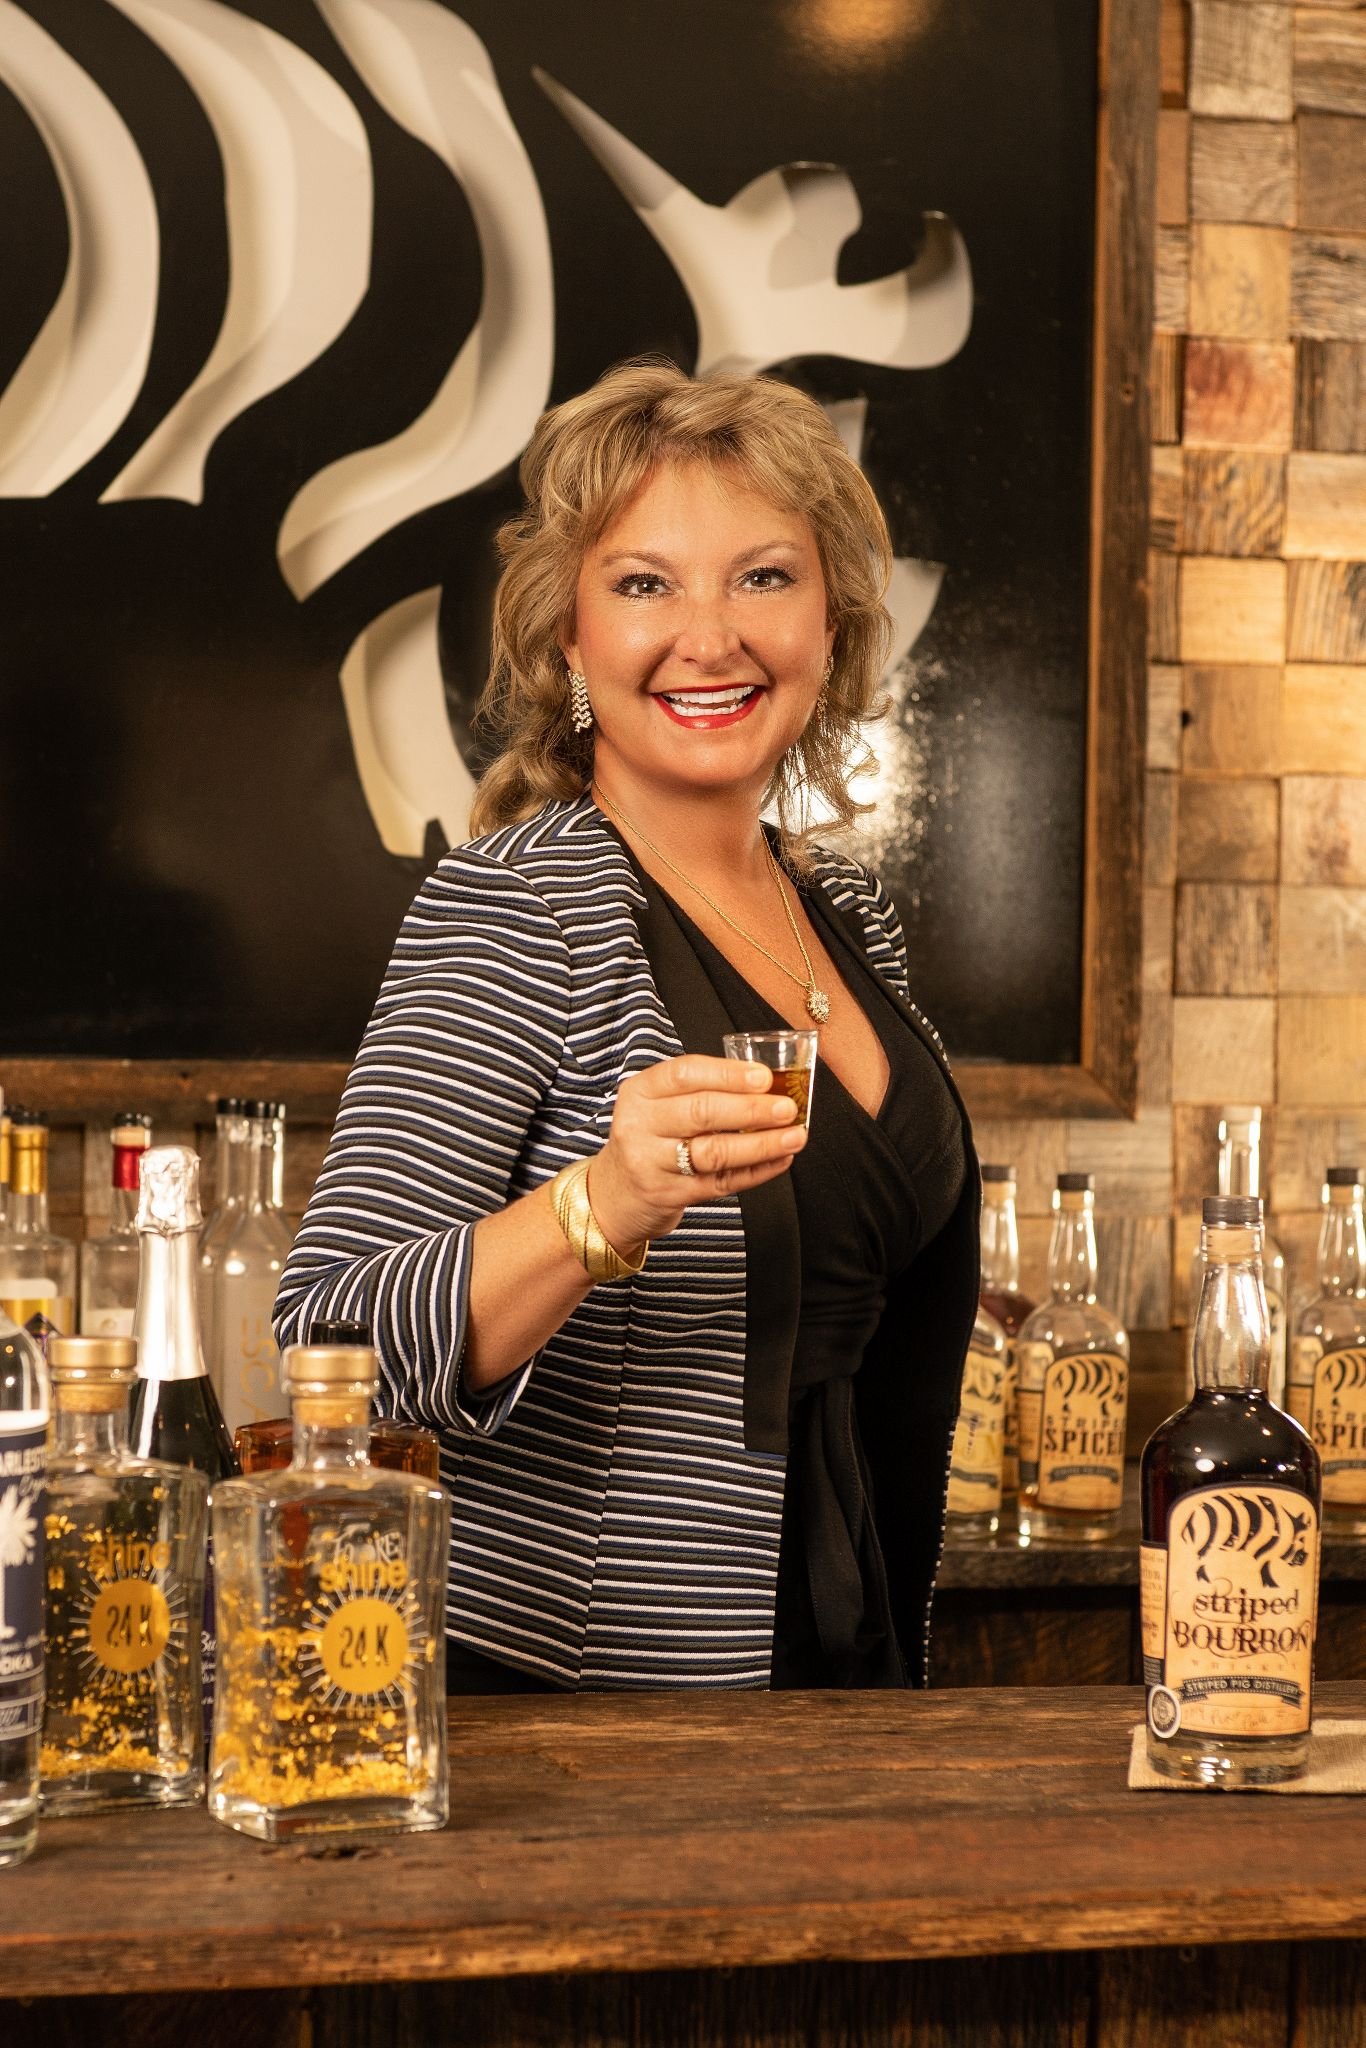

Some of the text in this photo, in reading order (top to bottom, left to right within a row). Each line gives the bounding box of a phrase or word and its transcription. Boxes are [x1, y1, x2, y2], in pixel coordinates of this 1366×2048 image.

[319, 1554, 409, 1593] shine
[1193, 1587, 1299, 1624] striped
[1172, 1620, 1310, 1656] BOURBON
[1186, 1679, 1299, 1695] STRIPED PIG DISTILLERY
